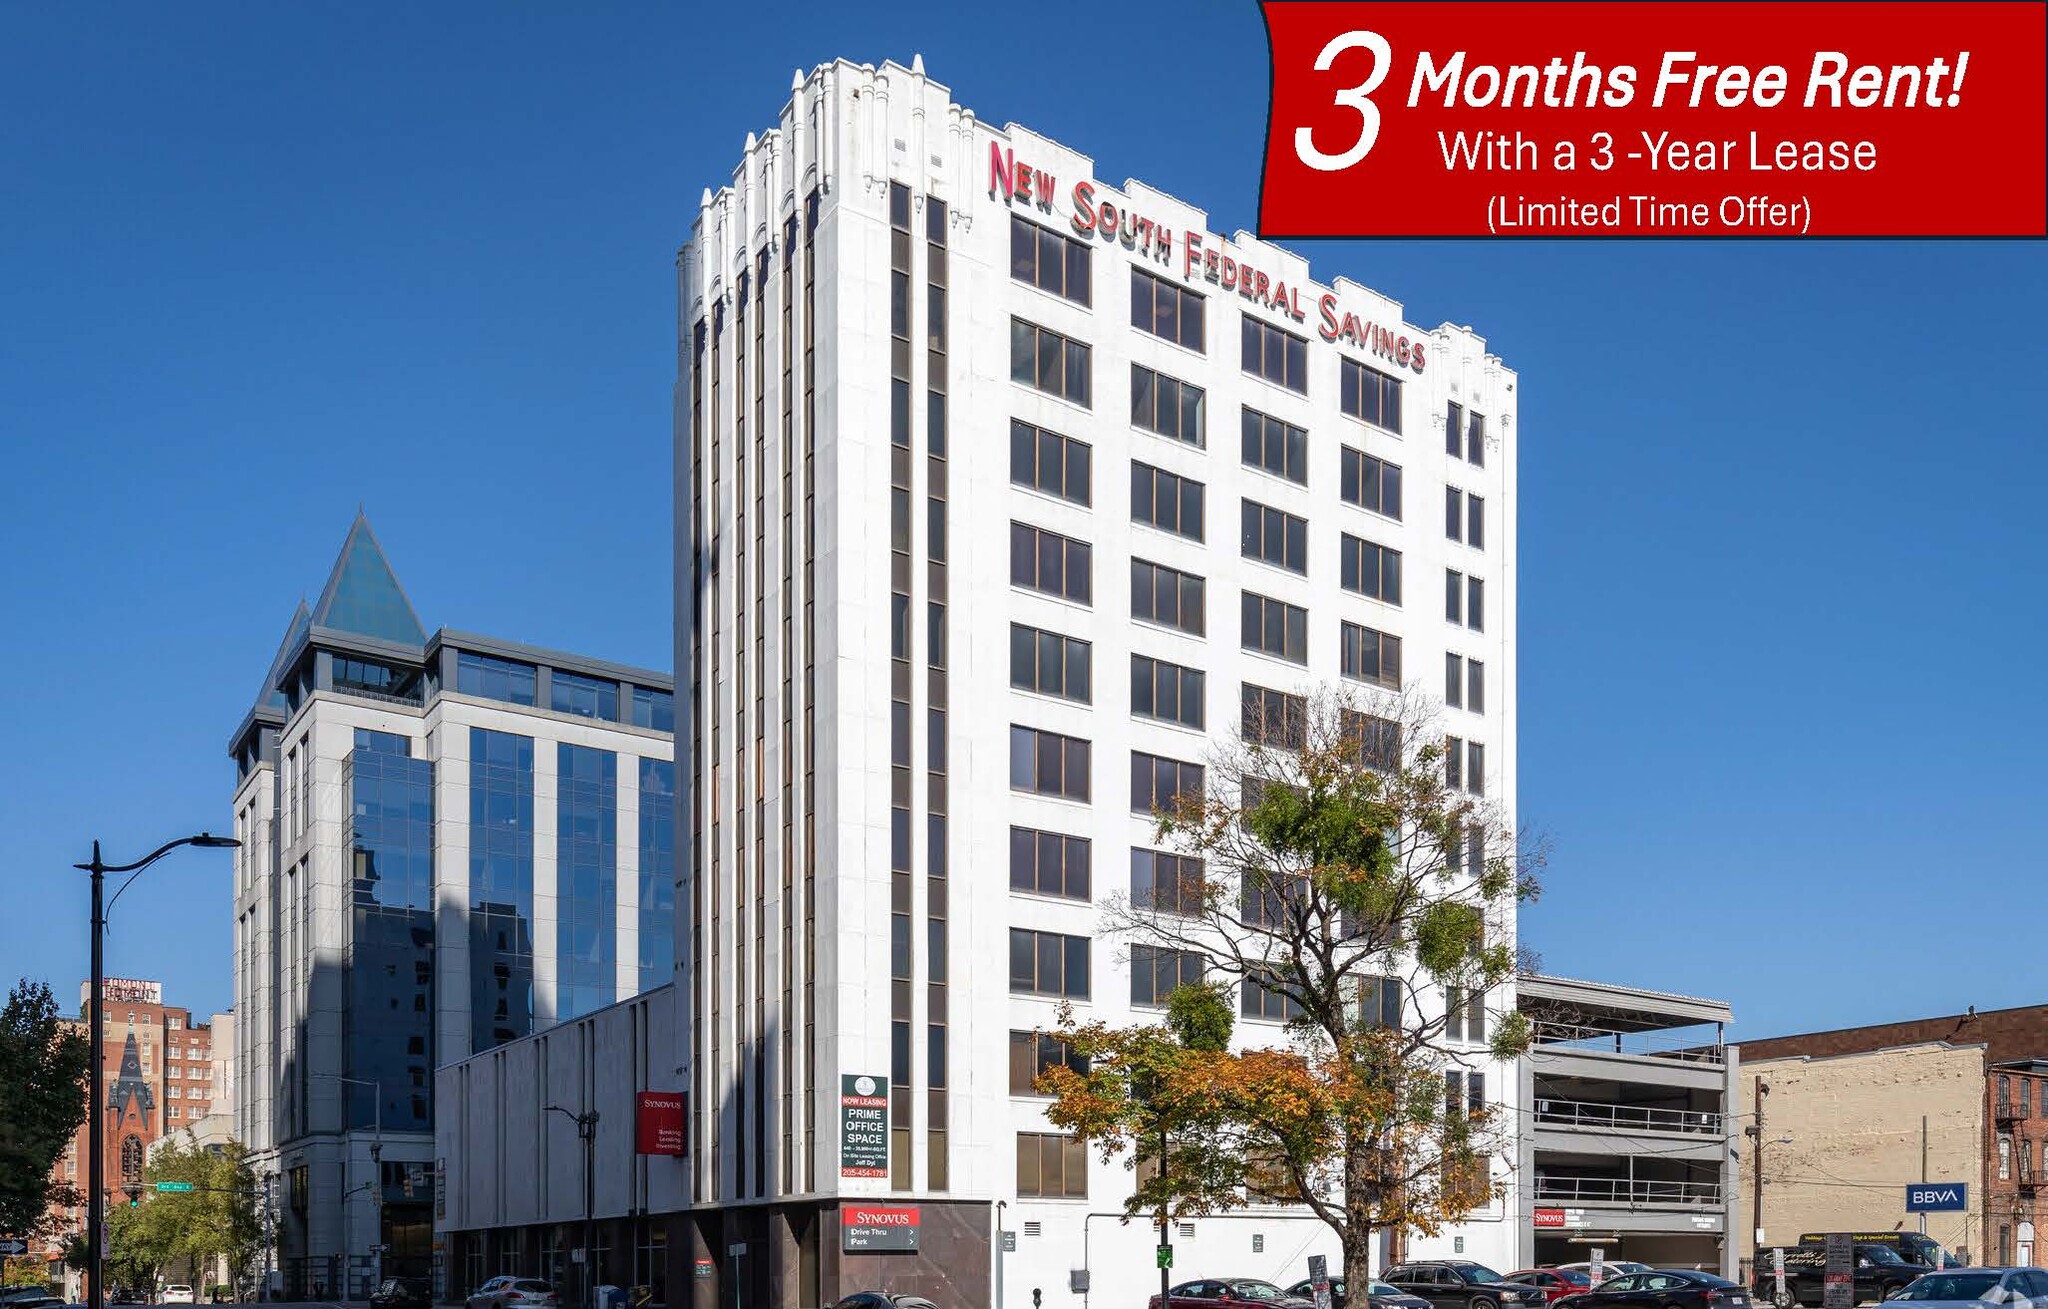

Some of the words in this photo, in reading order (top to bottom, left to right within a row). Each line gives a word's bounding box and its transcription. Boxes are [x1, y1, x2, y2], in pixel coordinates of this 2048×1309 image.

[988, 140, 1056, 207] NEW
[1070, 180, 1171, 260] SOUTH
[1184, 230, 1305, 322] FEDERAL
[1318, 293, 1426, 371] SAVINGS
[644, 1099, 681, 1109] SYNOVUS
[842, 1097, 860, 1105] NOW
[860, 1098, 887, 1107] LEASING
[848, 1109, 882, 1119] PRIME
[845, 1120, 885, 1132] OFFICE
[847, 1133, 883, 1144] SPACE
[1913, 1189, 1958, 1203] BBVA
[856, 1211, 909, 1225] SYNOVUS
[1535, 1213, 1564, 1223] SYNOVUS
[850, 1228, 870, 1236] Drive
[871, 1228, 887, 1236] Thru
